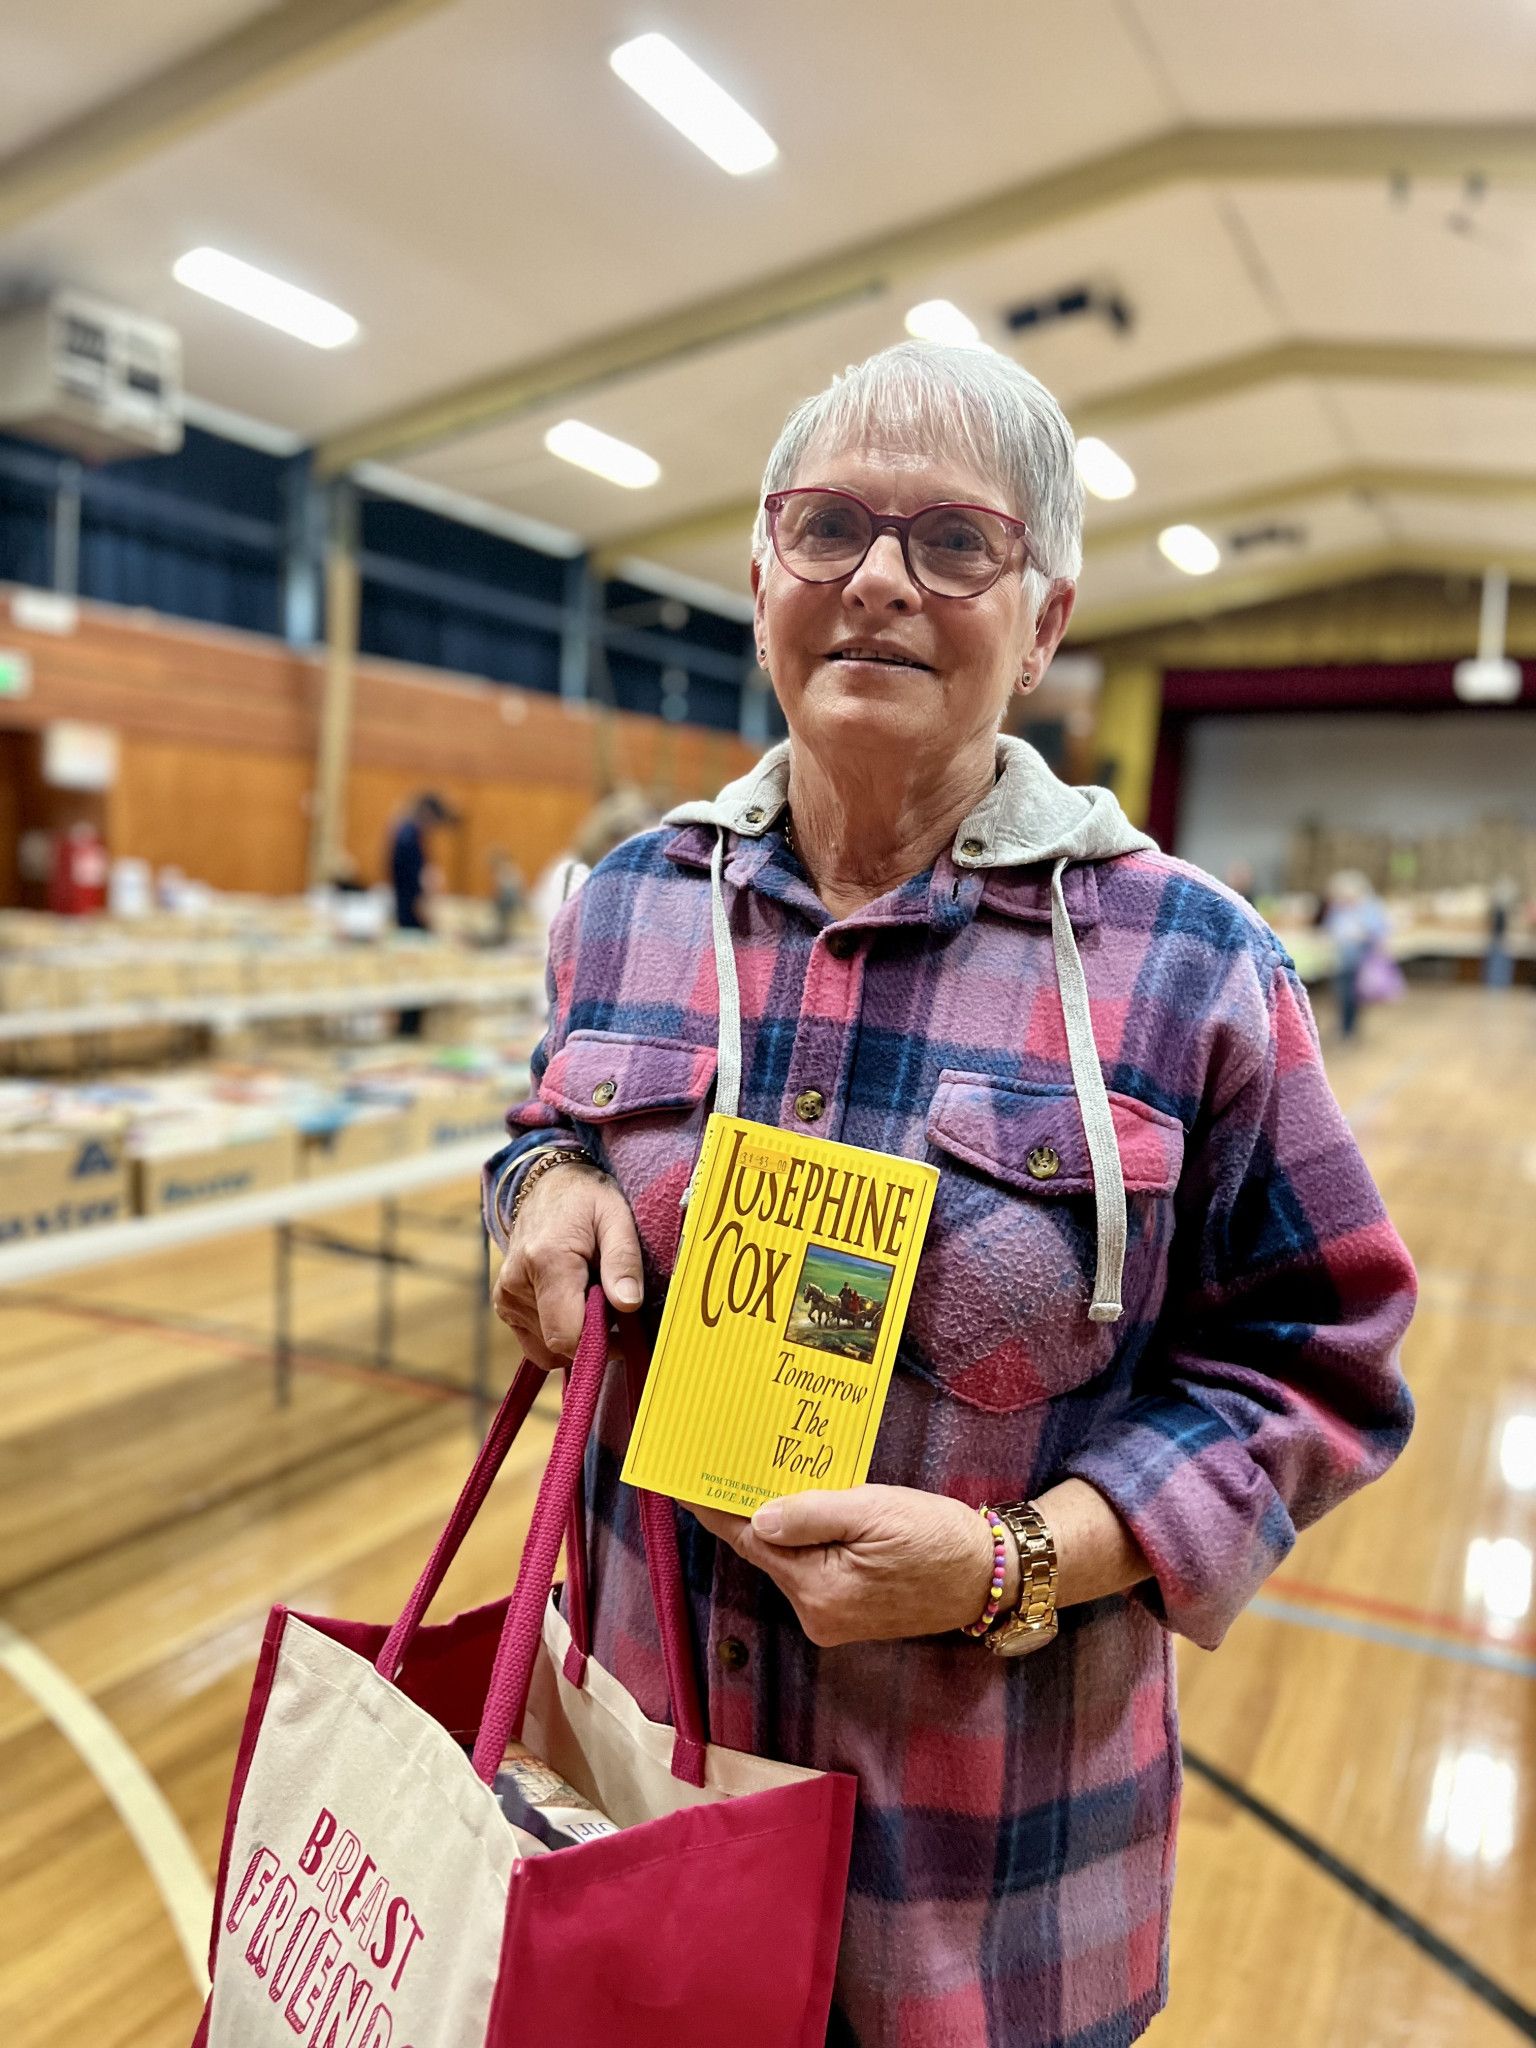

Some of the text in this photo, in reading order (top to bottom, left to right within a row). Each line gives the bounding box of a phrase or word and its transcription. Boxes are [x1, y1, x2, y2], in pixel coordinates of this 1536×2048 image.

[704, 1130, 914, 1256] JOSEPHINE
[701, 1221, 791, 1328] COX
[771, 1351, 868, 1405] Tomorrow
[791, 1399, 829, 1437] The
[701, 1472, 723, 1485] FROM
[724, 1478, 740, 1489] THE
[772, 1435, 834, 1480] World
[706, 1487, 737, 1503] LOVE
[740, 1495, 757, 1508] ME
[299, 1807, 424, 1991] BREAST
